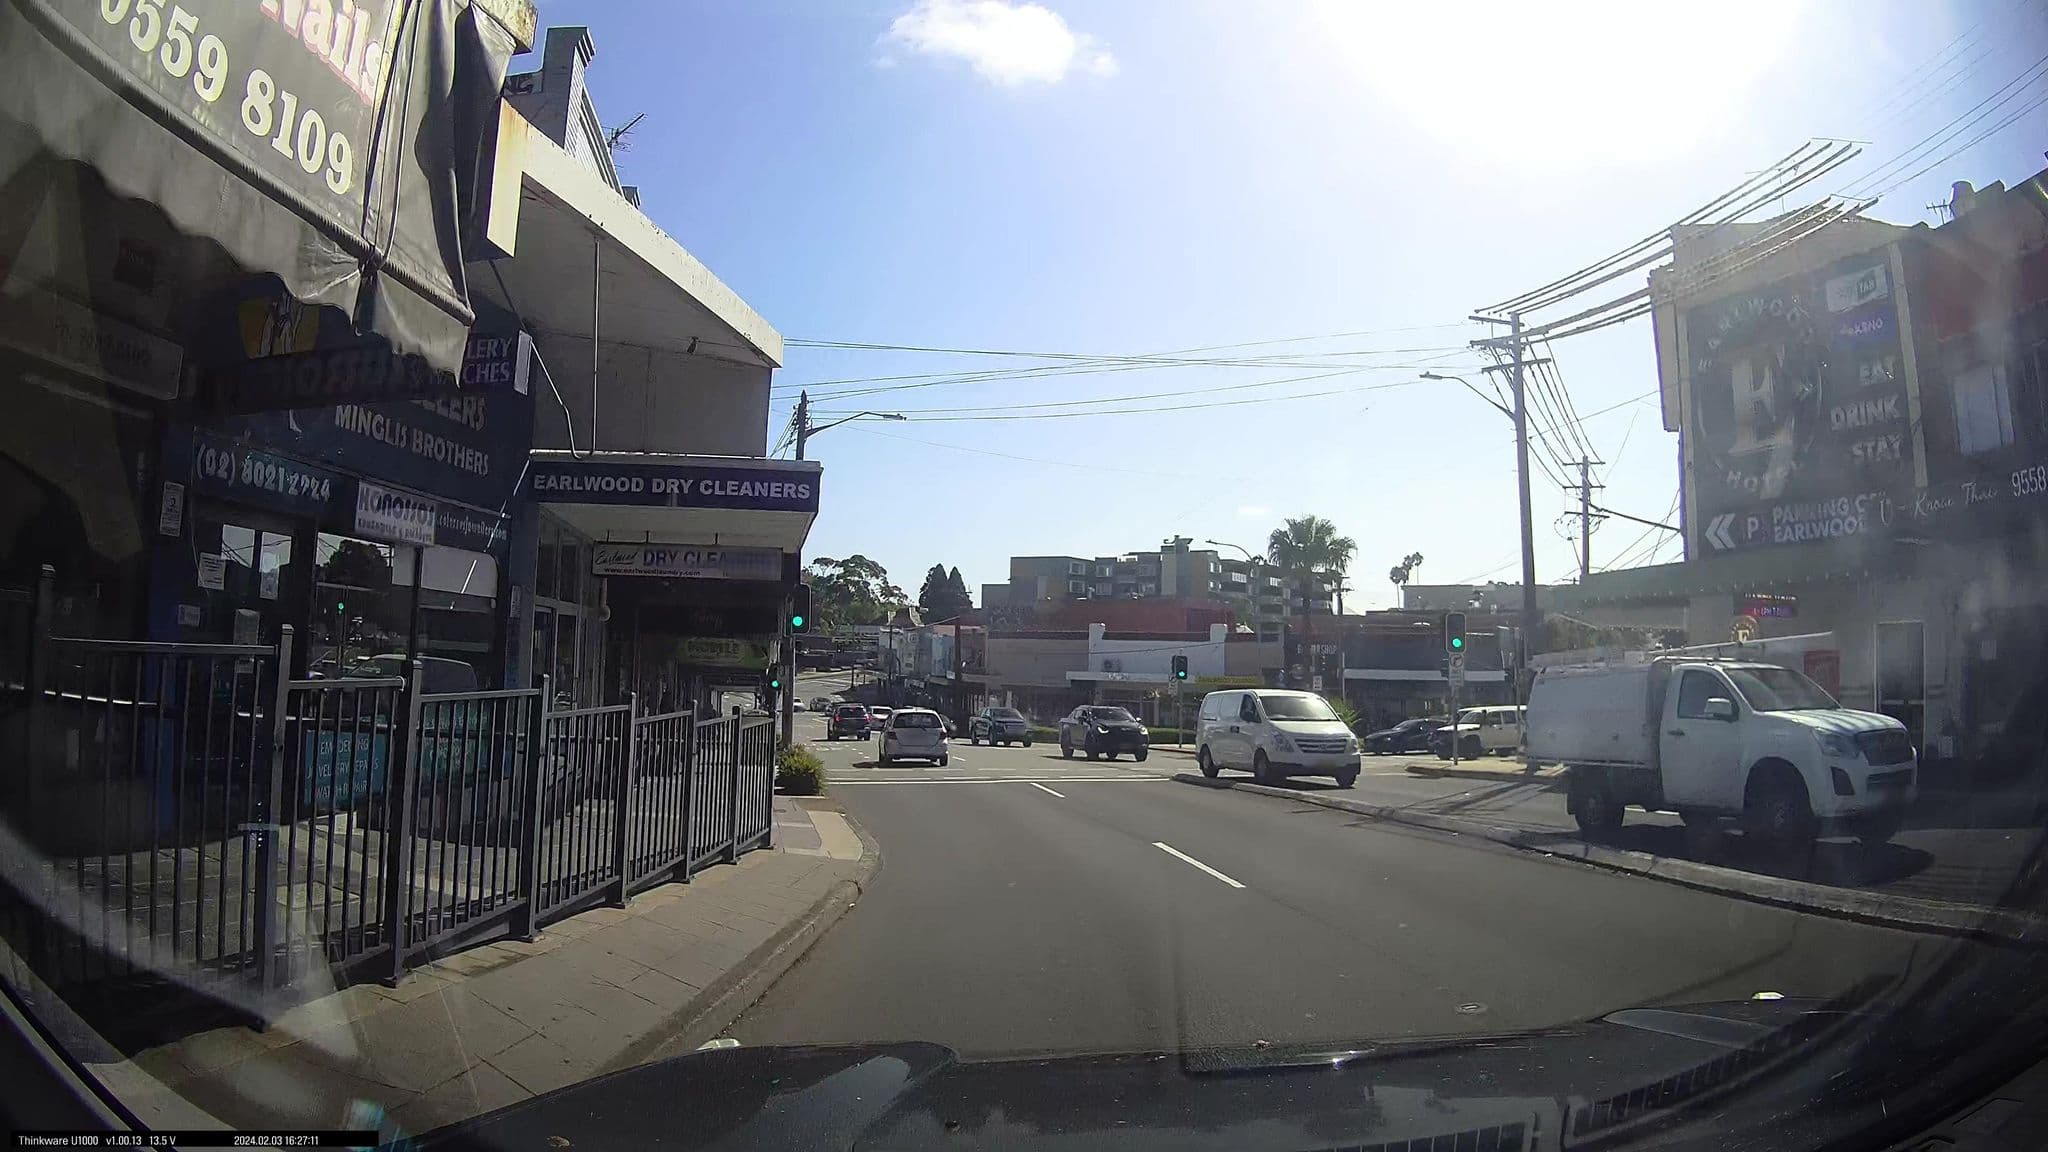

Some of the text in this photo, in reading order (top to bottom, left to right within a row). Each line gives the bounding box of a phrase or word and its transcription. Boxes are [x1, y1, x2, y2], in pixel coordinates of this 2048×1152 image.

[241, 69, 353, 196] 8109
[465, 336, 513, 360] LERY
[462, 361, 512, 384] CHES
[1829, 393, 1901, 432] DRINK
[334, 405, 490, 477] MINGLIS BROTHERS
[1851, 432, 1902, 459] STAY
[196, 443, 236, 488] (02)
[533, 474, 811, 499] EARLWOOD DRY CLEANERS
[2011, 465, 2047, 497] 9558
[642, 550, 681, 567] DRY
